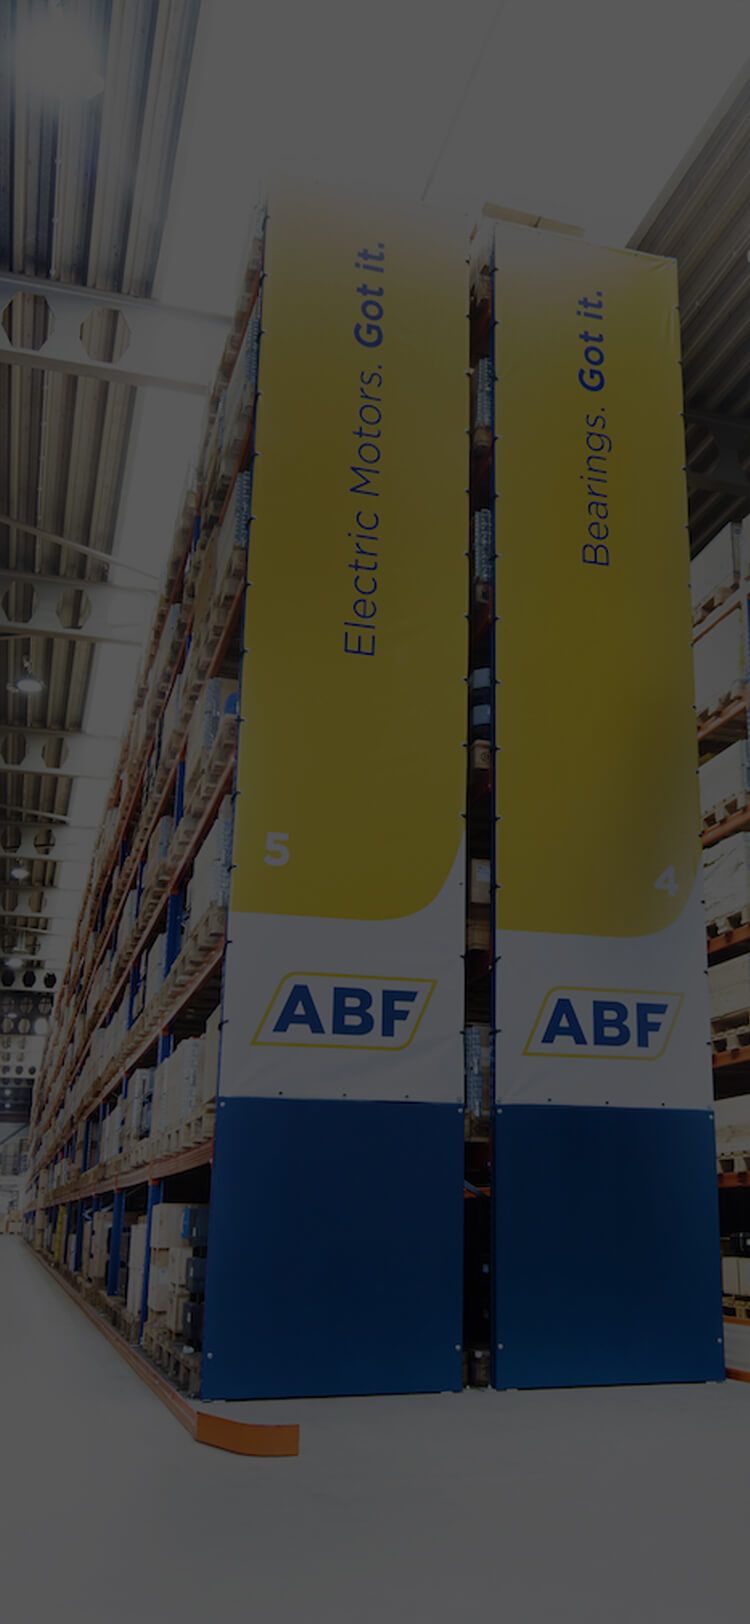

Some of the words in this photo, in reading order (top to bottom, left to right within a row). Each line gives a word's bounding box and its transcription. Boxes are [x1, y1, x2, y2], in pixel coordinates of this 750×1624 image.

[354, 242, 386, 274] it.
[353, 282, 385, 349] Got
[576, 290, 604, 321] it.
[577, 330, 606, 393] Got
[349, 362, 384, 497] Motors.
[580, 407, 612, 567] Bearings.
[343, 510, 381, 658] Electric
[264, 832, 290, 867] 5
[654, 865, 680, 897] 4
[272, 984, 418, 1037] ABF
[540, 997, 669, 1049] ABF
